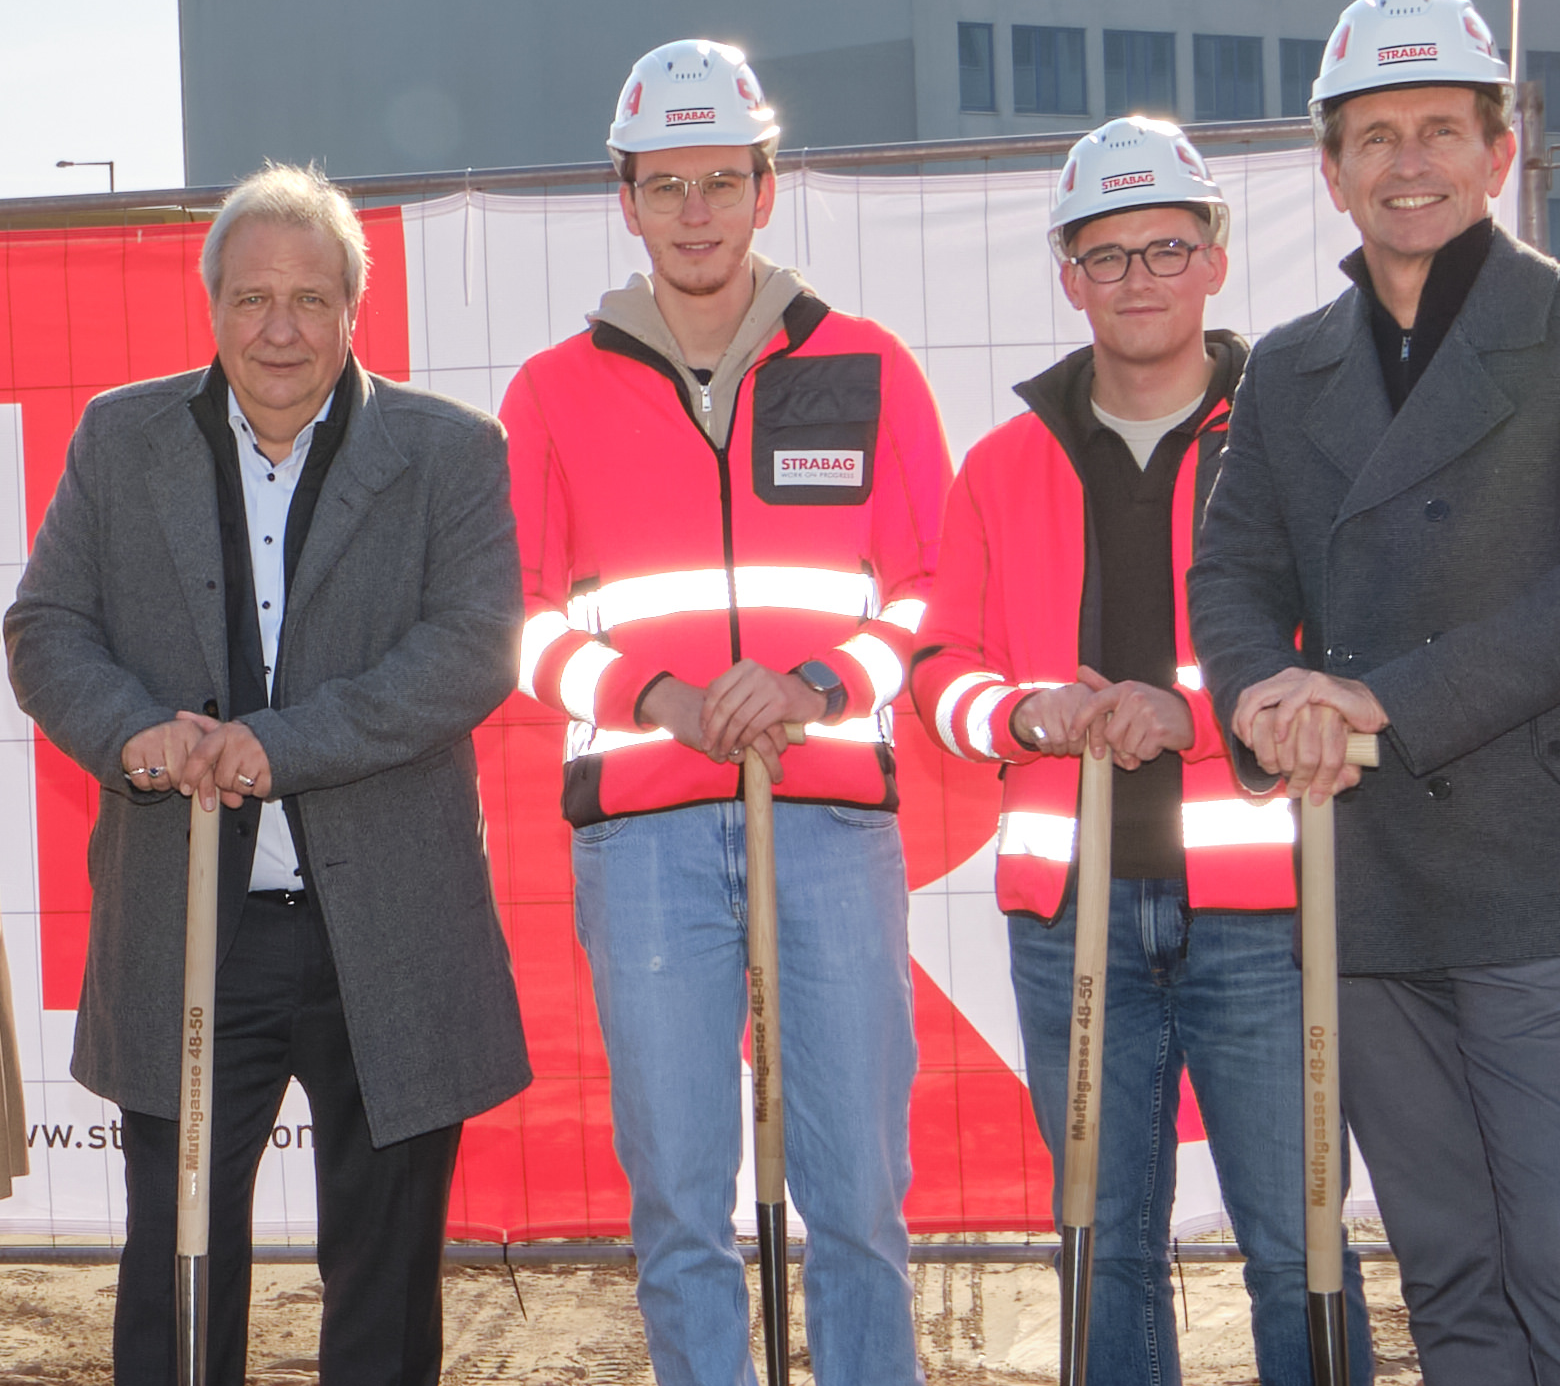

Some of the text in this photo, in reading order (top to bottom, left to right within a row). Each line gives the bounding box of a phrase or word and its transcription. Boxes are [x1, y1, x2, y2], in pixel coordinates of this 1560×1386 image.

[1378, 46, 1439, 62] STRABAG
[666, 110, 716, 123] STRABAG
[1101, 173, 1155, 190] STRABAG
[781, 458, 855, 471] STRABAG
[1072, 975, 1093, 1141] Muthgasse 48-50
[185, 1006, 204, 1171] Muthgasse 48-50
[1309, 1025, 1330, 1207] Muthgasse 48-50
